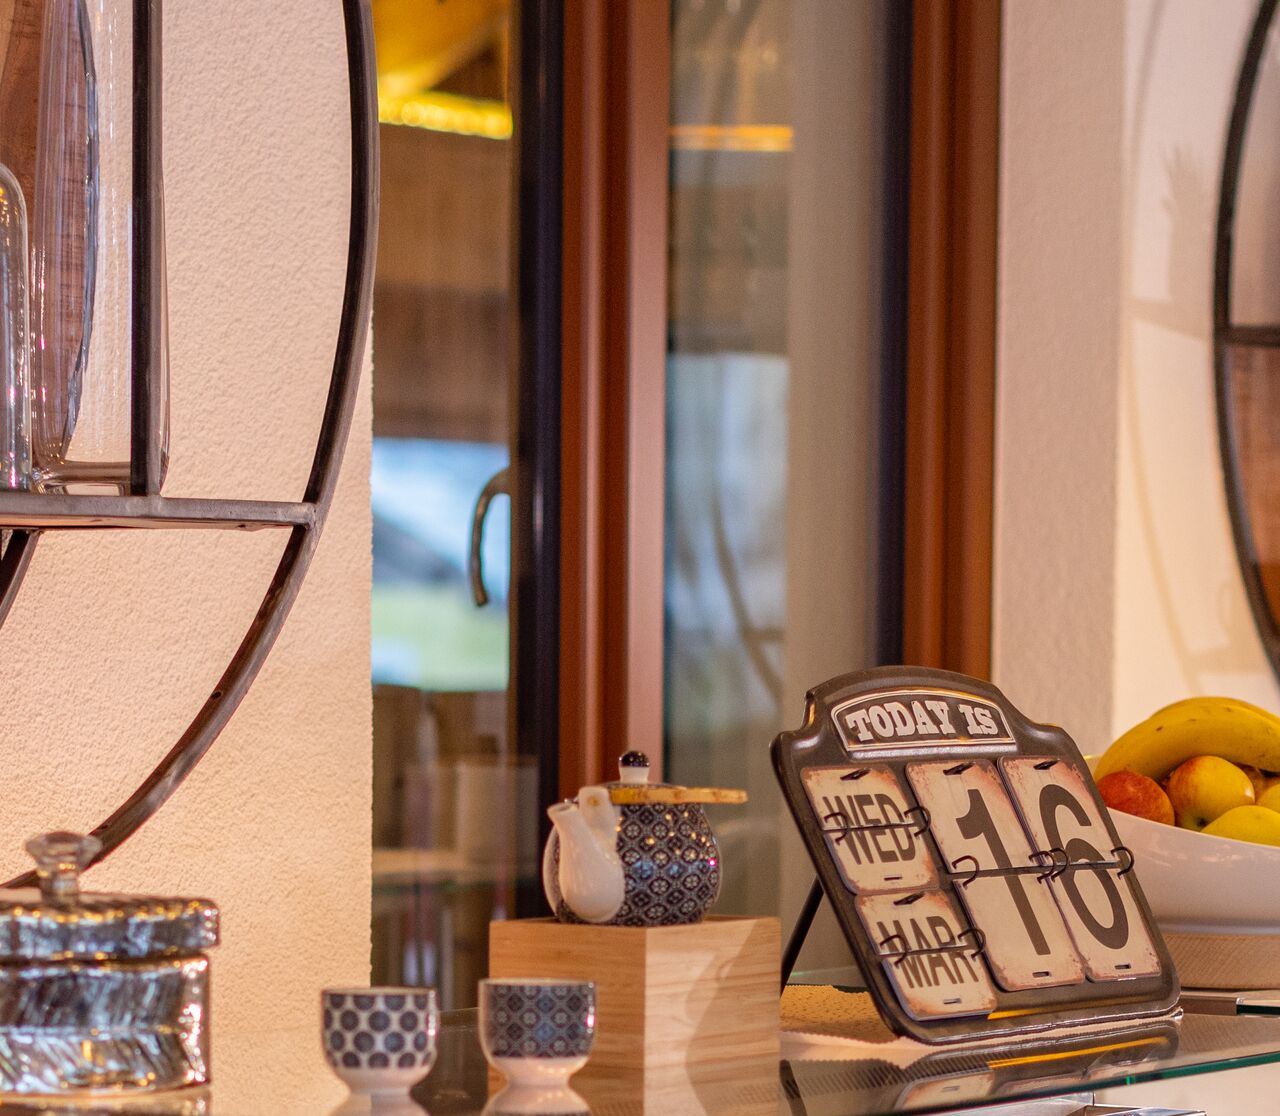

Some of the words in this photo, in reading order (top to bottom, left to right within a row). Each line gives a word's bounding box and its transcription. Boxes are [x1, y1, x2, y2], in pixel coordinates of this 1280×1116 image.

[846, 702, 953, 741] TODAY
[958, 704, 999, 736] IS
[822, 793, 917, 865] WED
[955, 783, 1129, 955] 16
[877, 915, 980, 989] MAR
